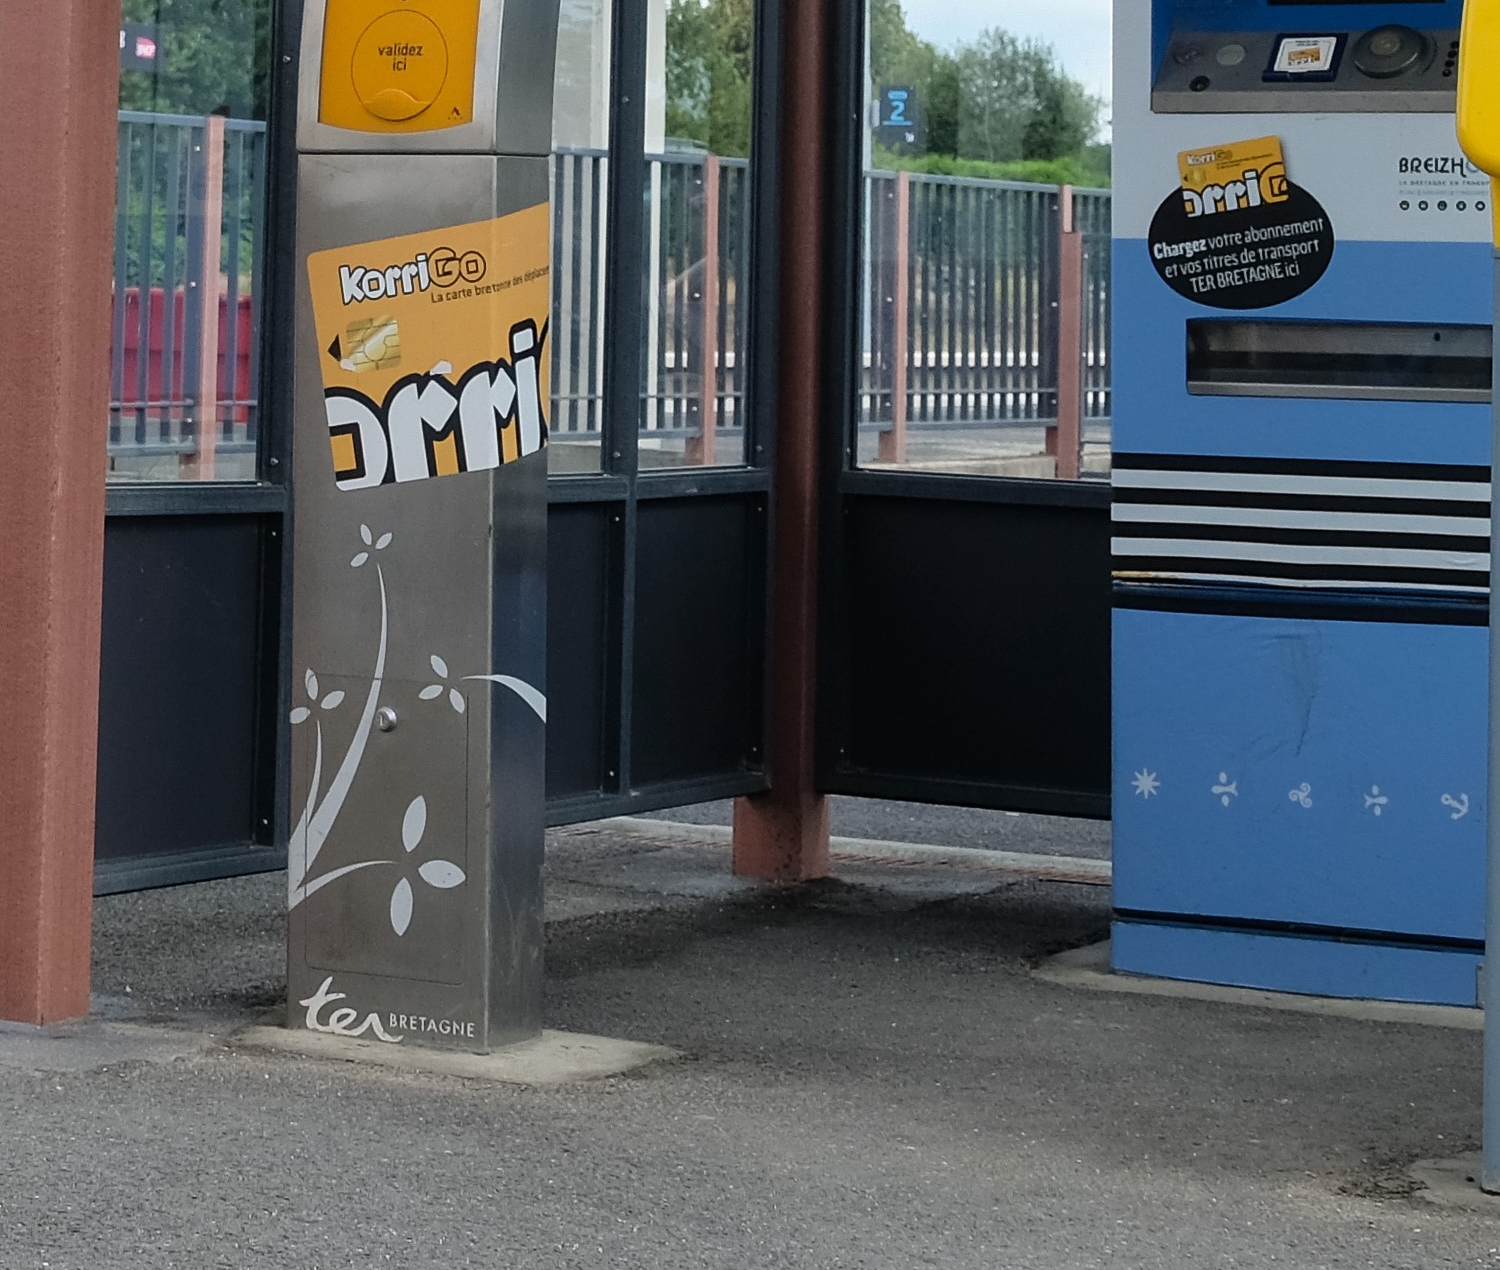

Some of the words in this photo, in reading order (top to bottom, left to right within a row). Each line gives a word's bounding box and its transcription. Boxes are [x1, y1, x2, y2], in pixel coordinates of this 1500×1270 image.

[378, 42, 423, 59] validez
[392, 57, 407, 72] ici
[890, 101, 905, 121] 2
[1154, 238, 1207, 259] Chargez
[1208, 231, 1242, 248] votre
[1244, 218, 1323, 242] abonnement
[1165, 262, 1178, 278] et
[1180, 259, 1201, 275] vos
[1204, 253, 1239, 270] titres
[1240, 248, 1257, 263] de
[1259, 239, 1319, 259] transport
[338, 246, 486, 306] KorriGo
[1190, 276, 1216, 293] TER
[1217, 262, 1284, 288] BRETAGNE
[1284, 260, 1300, 277] ici
[430, 291, 444, 304] La
[445, 288, 472, 301] carte
[299, 976, 403, 1042] ter
[389, 1014, 476, 1039] BRETAGNE
